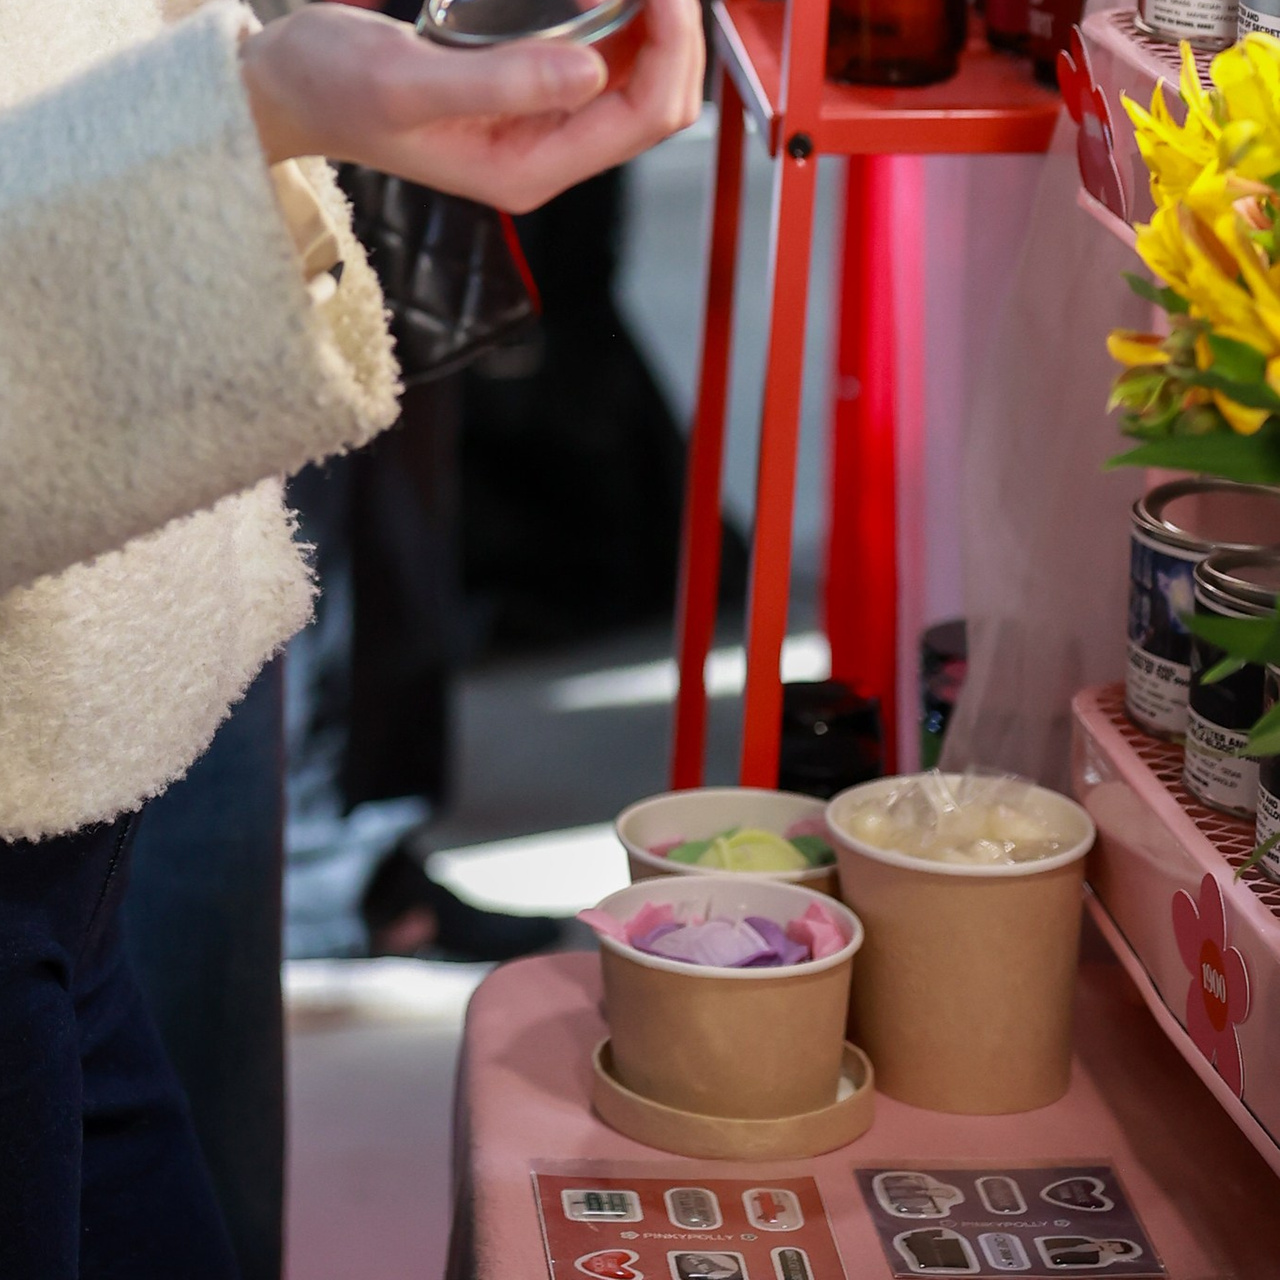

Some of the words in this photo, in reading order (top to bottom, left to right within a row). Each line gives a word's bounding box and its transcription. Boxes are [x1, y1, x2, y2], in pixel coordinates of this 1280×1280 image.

[1246, 11, 1260, 22] AND
[1252, 23, 1280, 38] SECRET
[1202, 962, 1226, 1004] 1900
[642, 1232, 734, 1241] PINKYPOLLY
